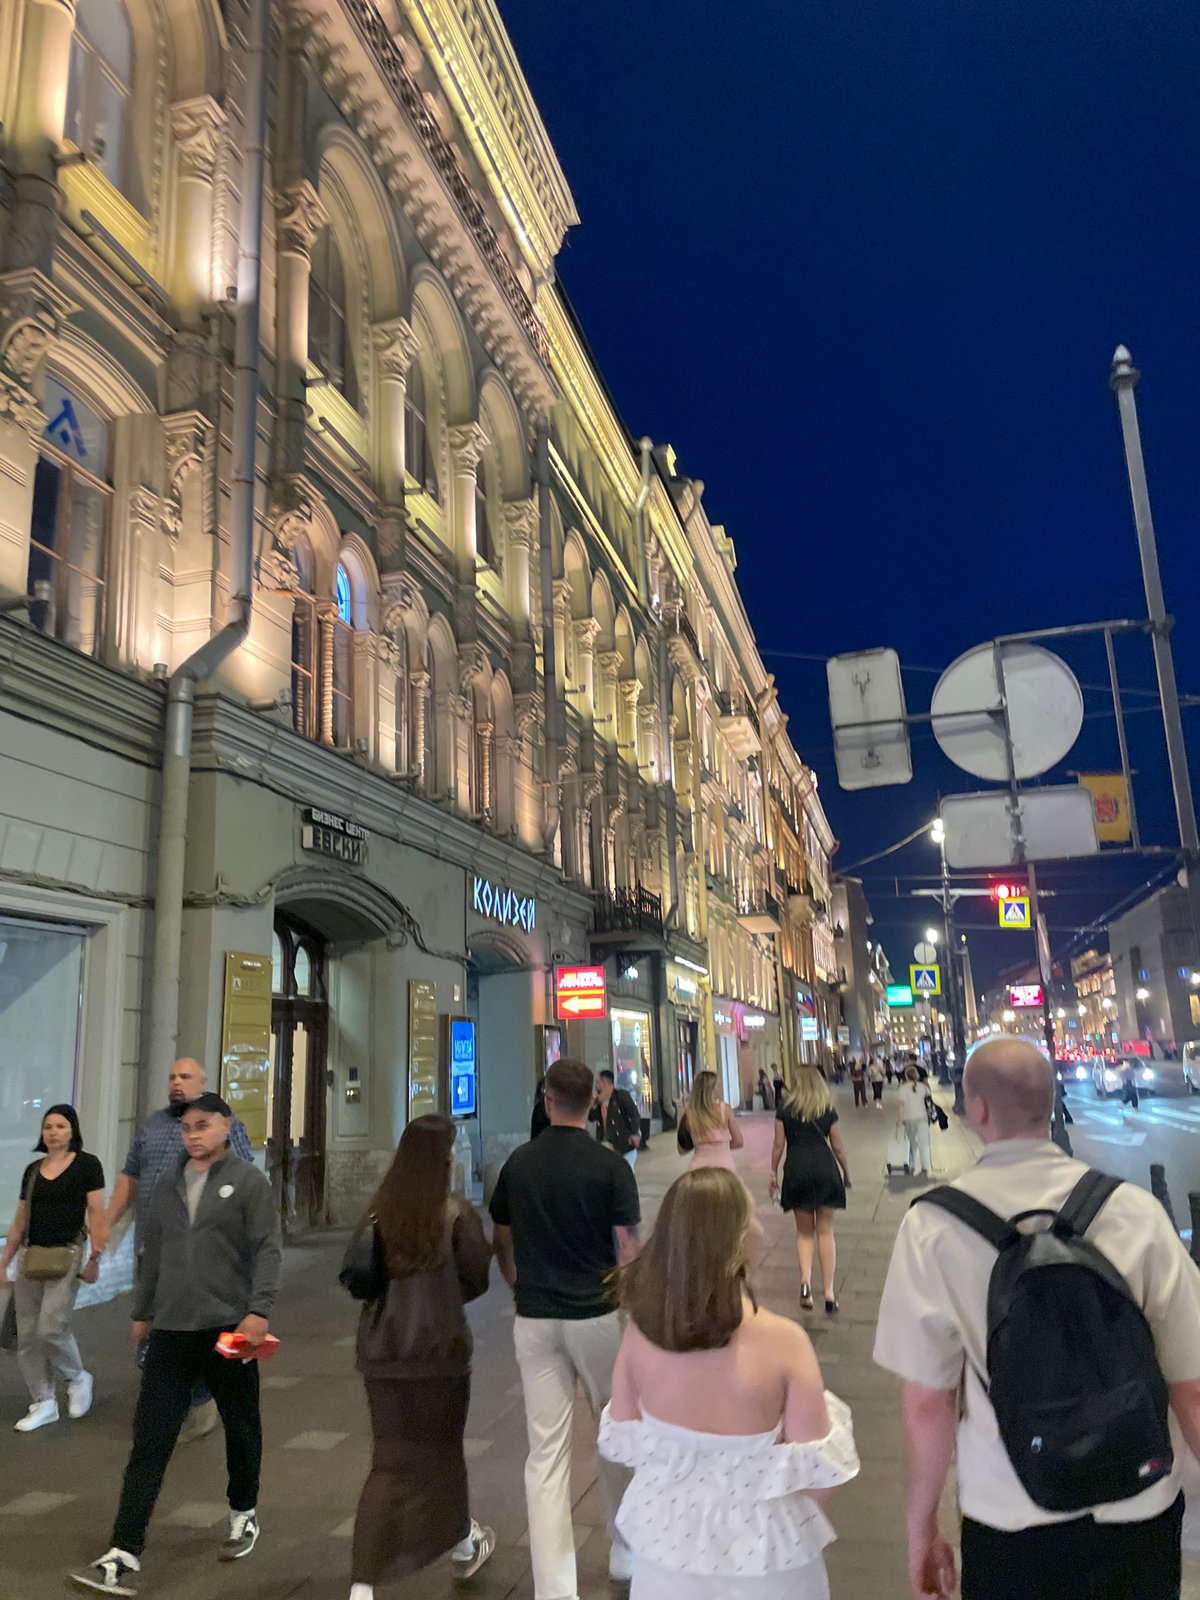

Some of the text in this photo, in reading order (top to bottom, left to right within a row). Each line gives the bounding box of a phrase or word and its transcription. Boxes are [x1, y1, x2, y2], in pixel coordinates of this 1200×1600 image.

[311, 807, 370, 840] БИЗНЕС ЦЕНТР
[473, 875, 536, 933] КОЛИЗЕЙ
